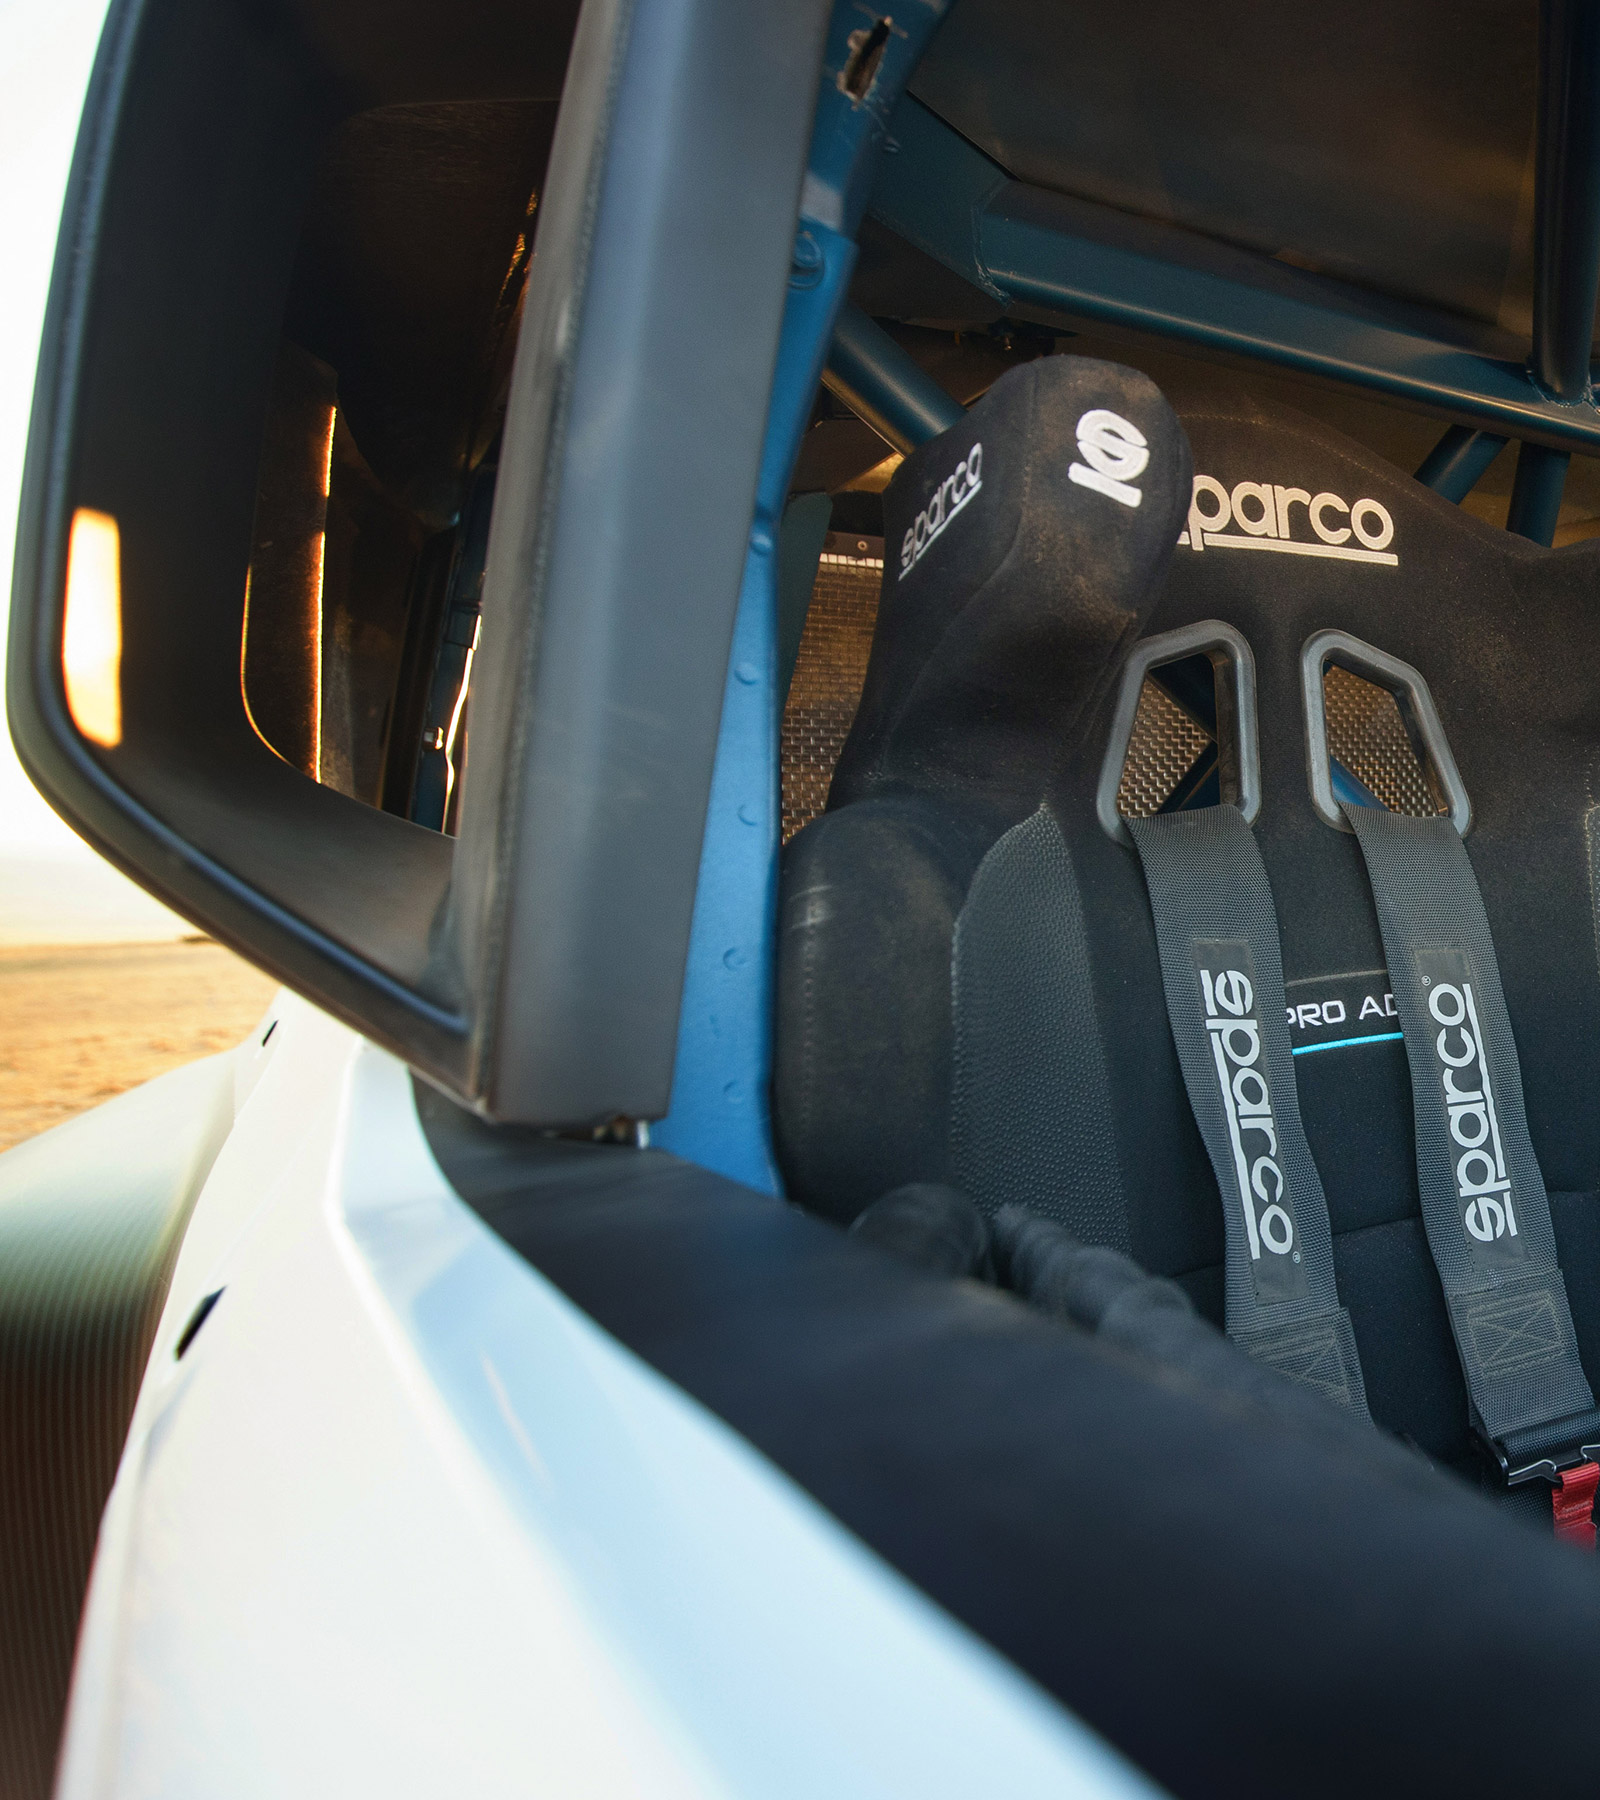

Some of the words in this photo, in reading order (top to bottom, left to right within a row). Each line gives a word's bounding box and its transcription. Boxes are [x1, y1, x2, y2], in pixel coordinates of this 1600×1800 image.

[898, 442, 983, 581] sparco
[1177, 474, 1398, 566] parco
[1200, 969, 1294, 1260] sparco
[1428, 982, 1518, 1242] sparco
